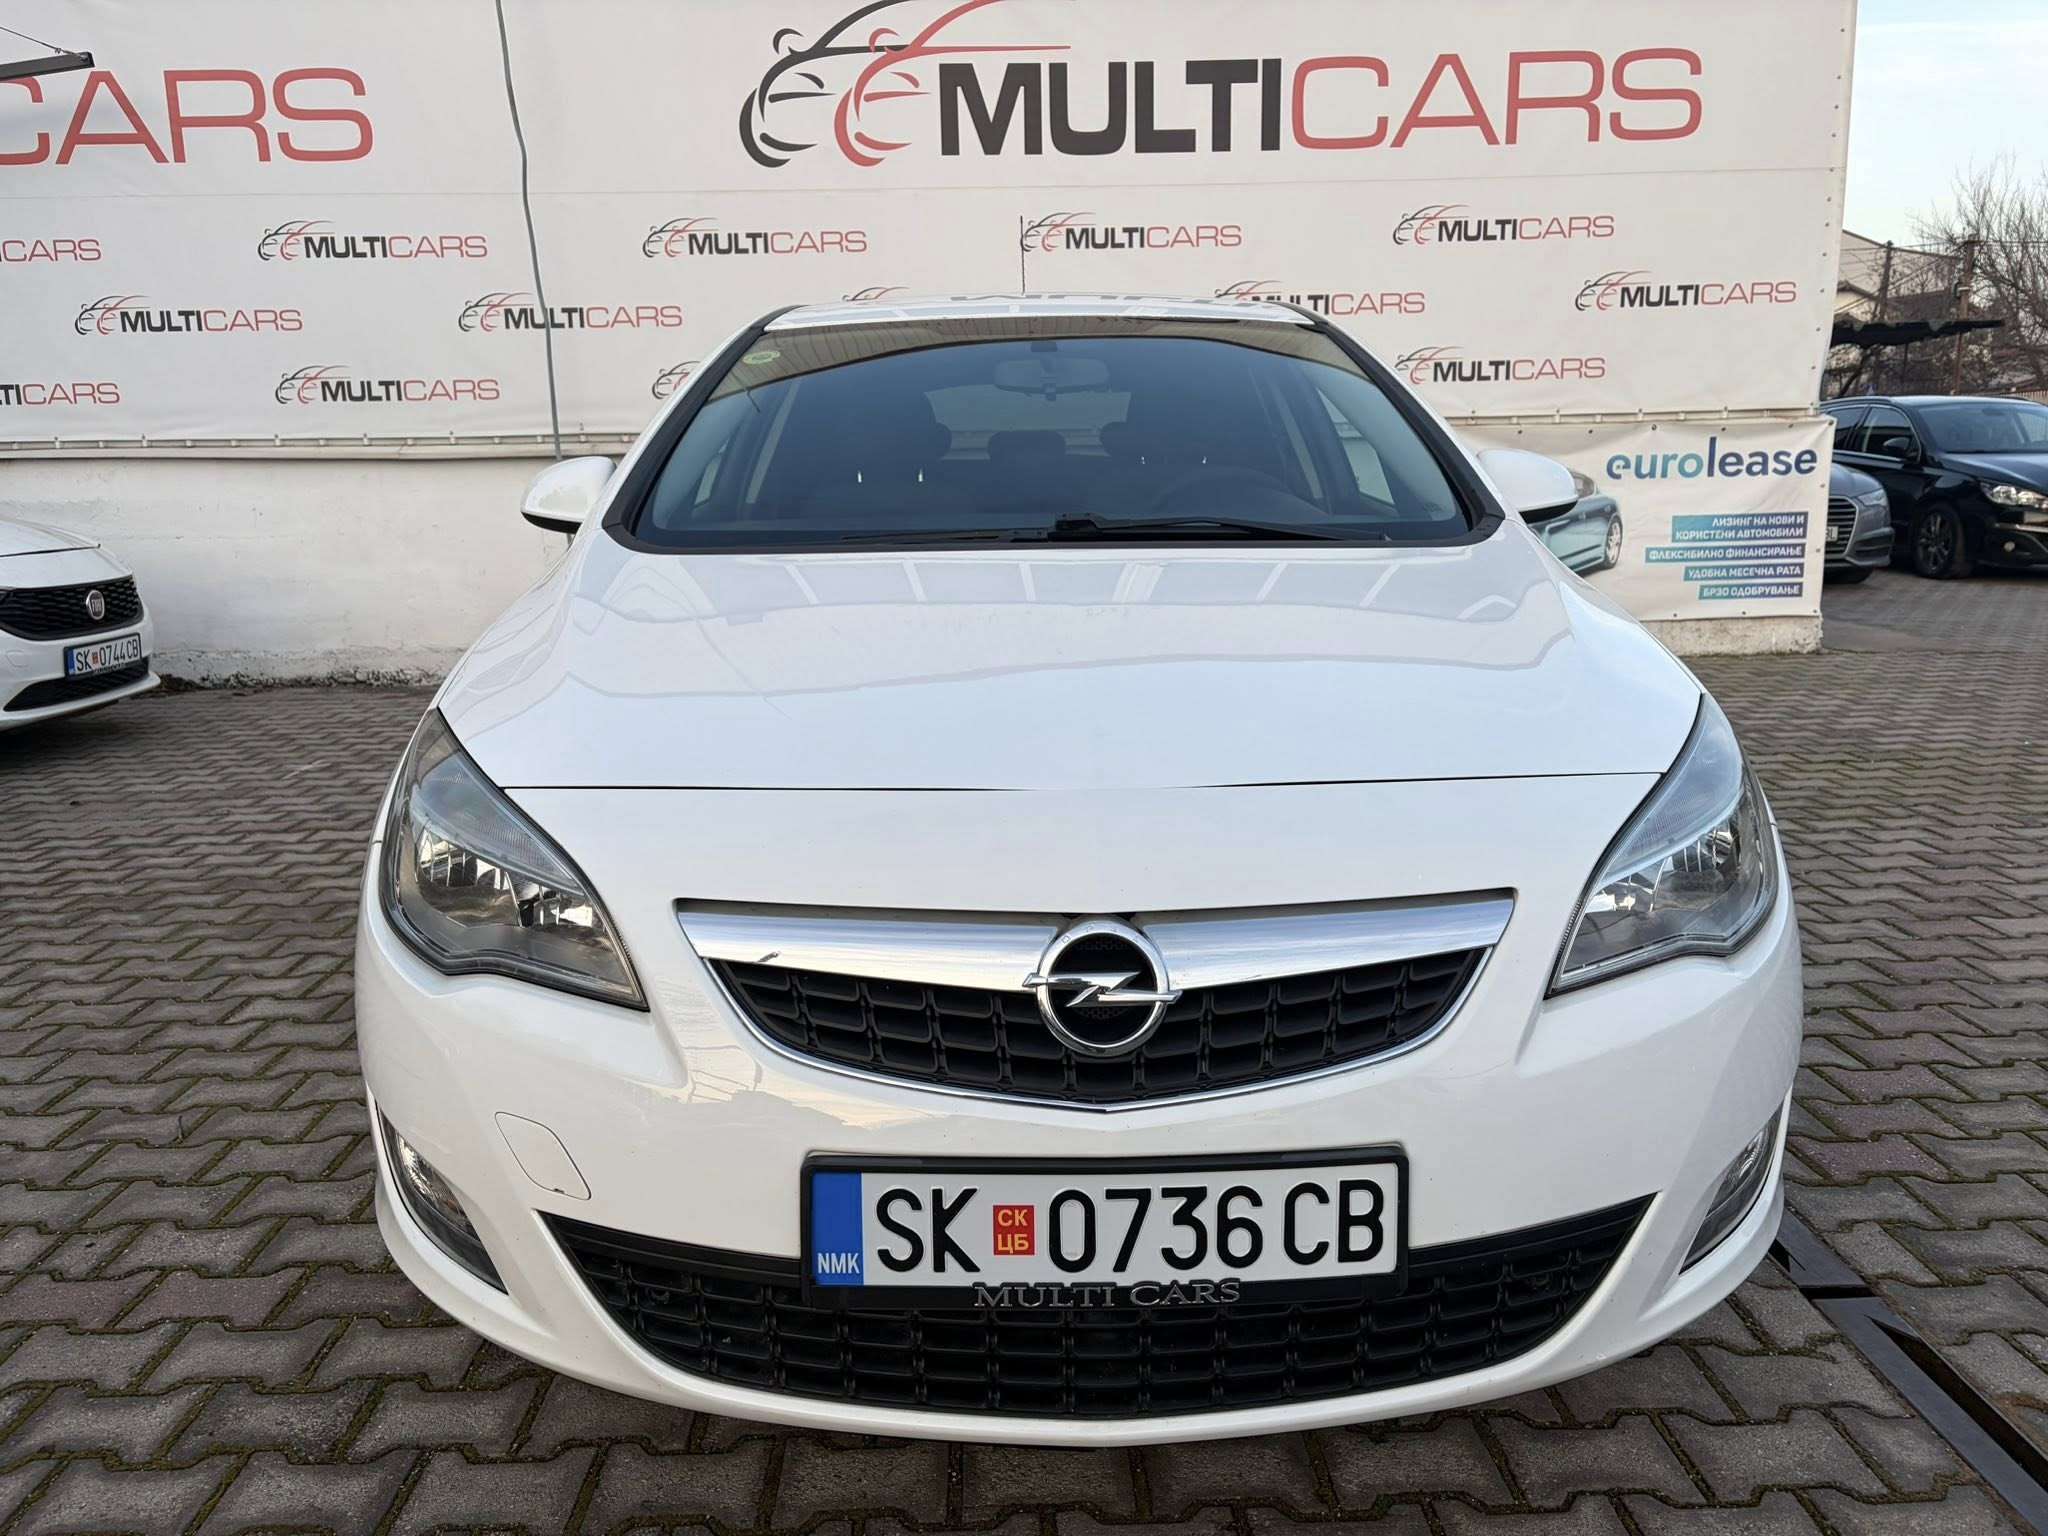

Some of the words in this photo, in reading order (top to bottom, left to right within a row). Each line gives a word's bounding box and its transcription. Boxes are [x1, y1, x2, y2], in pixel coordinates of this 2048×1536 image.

[938, 47, 1703, 156] MULTICARS
[1064, 224, 1242, 250] MULTICARS
[1437, 214, 1615, 243] MULTICARS
[0, 239, 102, 262] CARS
[304, 234, 488, 259] MULTICARS
[687, 230, 867, 256] MULTICARS
[1251, 293, 1425, 316] TICARS
[1619, 281, 1797, 308] MULTICARS
[119, 308, 303, 333] MULTICARS
[503, 305, 683, 330] MULTICARS
[1432, 357, 1606, 383] MULTICARS
[0, 383, 120, 406] TICARS
[320, 379, 500, 403] MULTICARS
[1606, 436, 1817, 480] eurolease
[1675, 529, 1736, 540] КОРИСТЕНИ
[1737, 527, 1804, 538] АВТОМОБИЛИ
[1712, 515, 1752, 527] ЛИЗИНГ
[1753, 515, 1767, 525] НА
[1768, 515, 1795, 525] НОВИ
[1728, 566, 1775, 577] МЕСЕЧНА
[1776, 565, 1801, 575] РАТА
[76, 649, 92, 671] SK
[876, 1188, 981, 1273] SK
[816, 1252, 860, 1274] NMK
[973, 1285, 1116, 1308] MULTI
[1130, 1281, 1241, 1306] CARS
